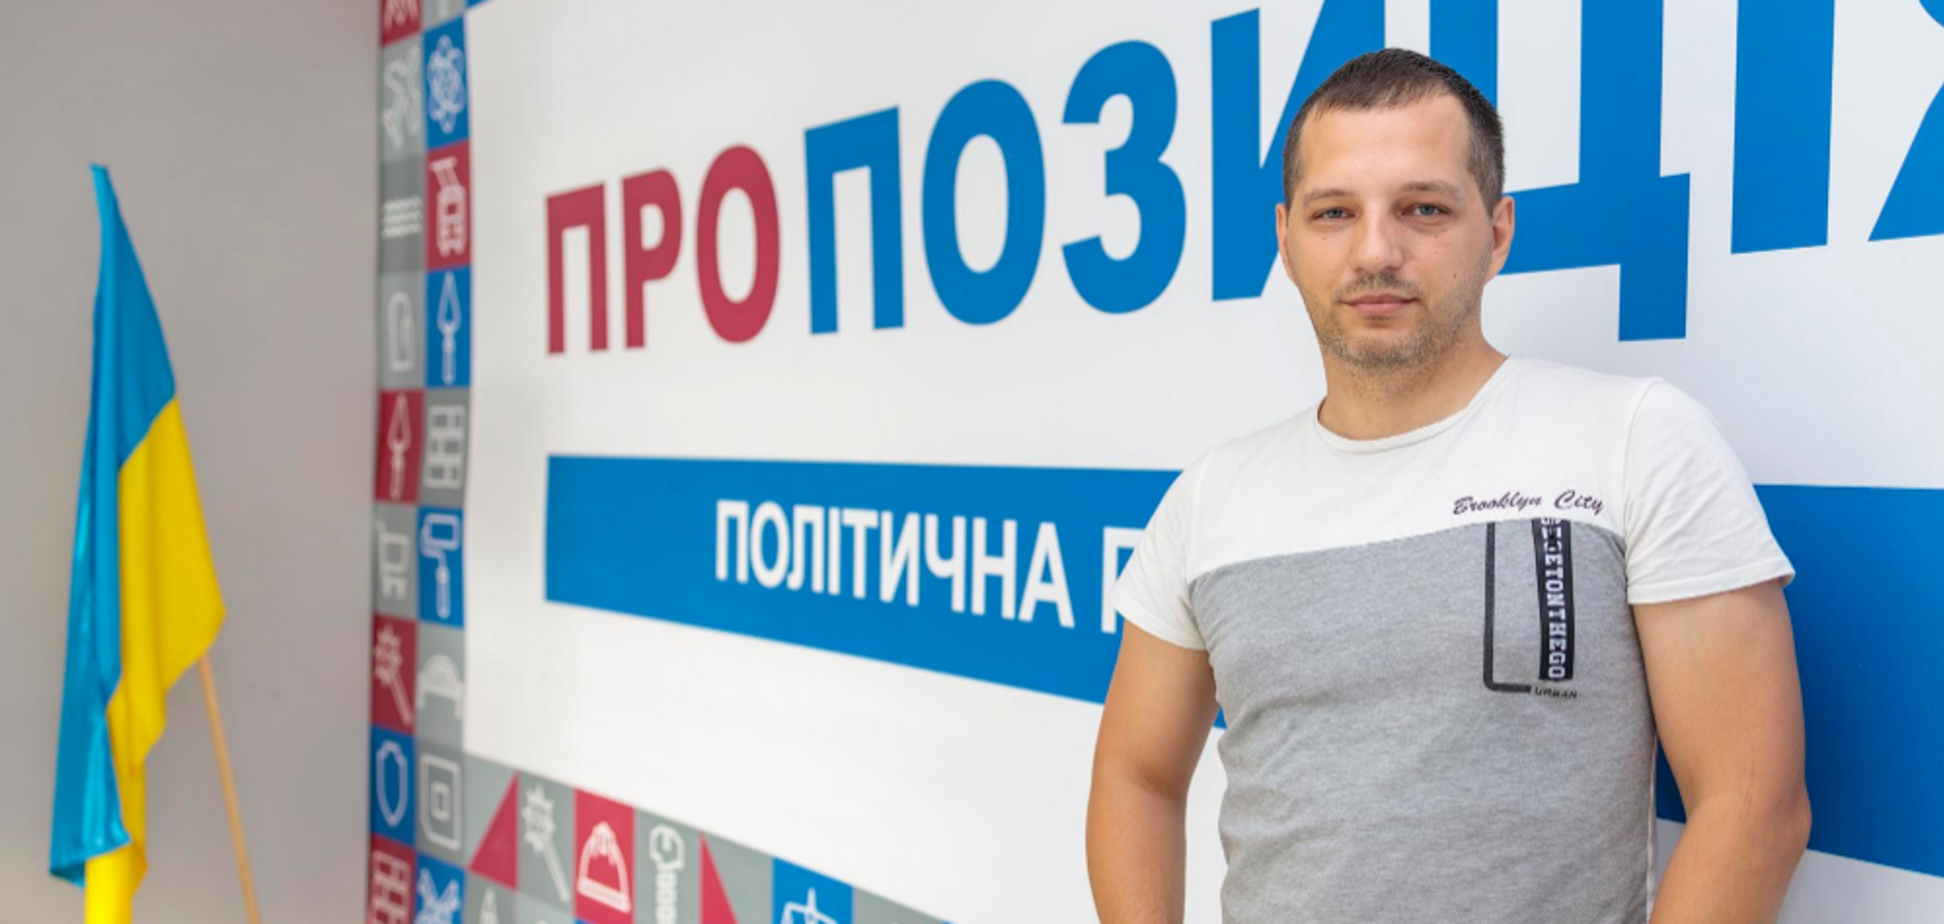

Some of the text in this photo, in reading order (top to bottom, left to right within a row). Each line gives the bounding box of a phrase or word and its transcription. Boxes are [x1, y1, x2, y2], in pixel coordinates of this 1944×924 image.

[1453, 489, 1604, 516] Brooklyn City
[716, 499, 1075, 628] ПОЛІТИЧНА
